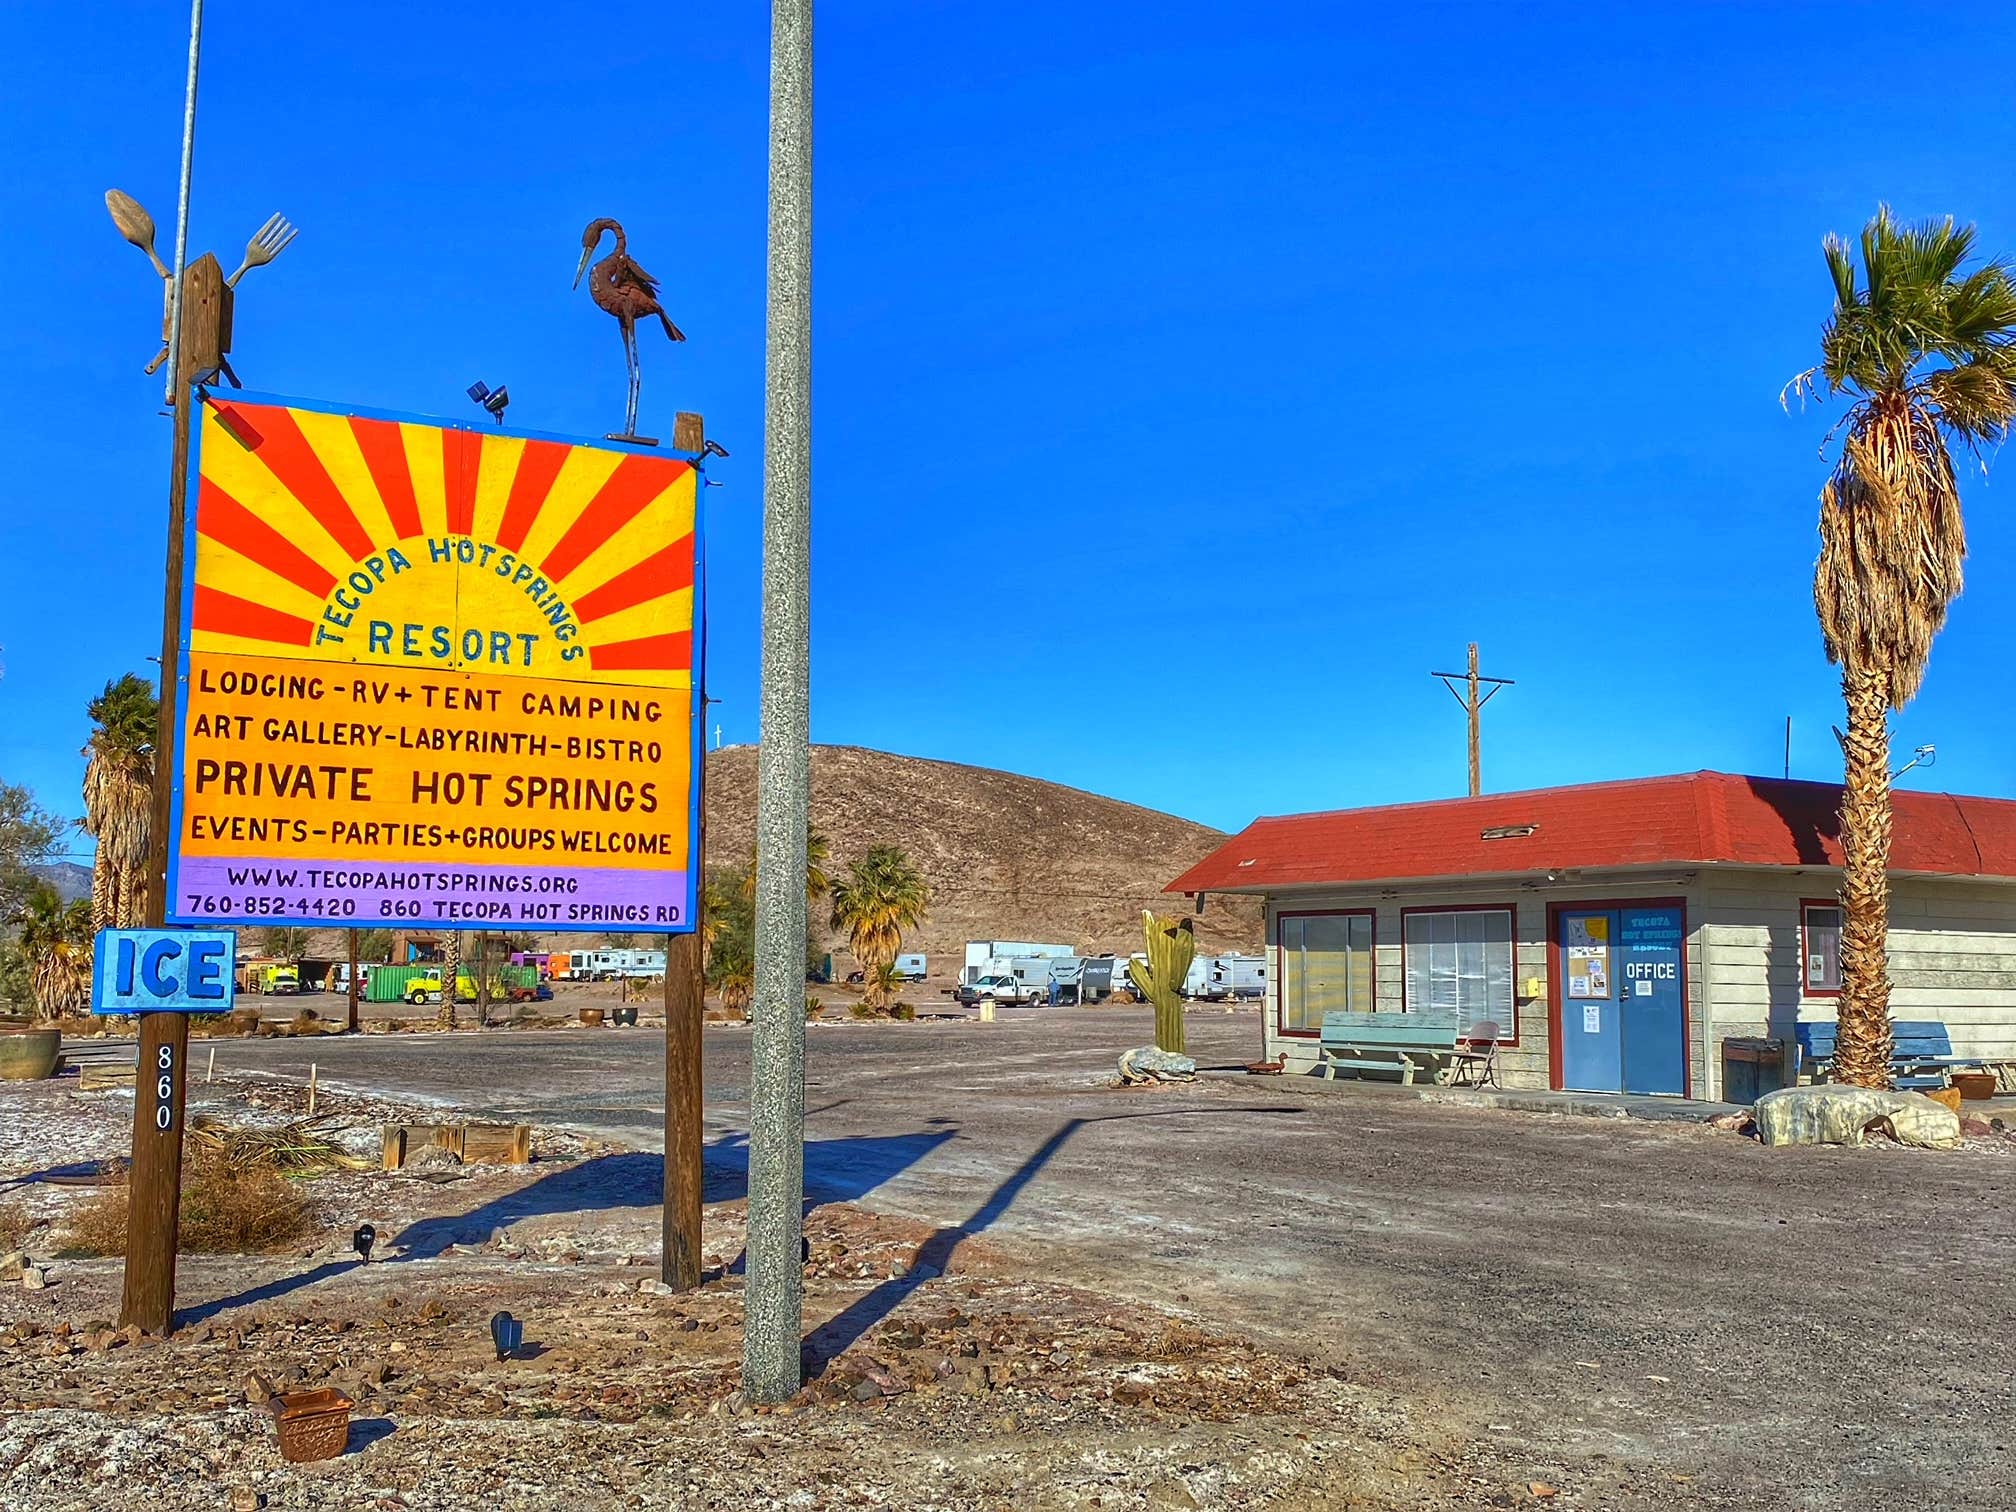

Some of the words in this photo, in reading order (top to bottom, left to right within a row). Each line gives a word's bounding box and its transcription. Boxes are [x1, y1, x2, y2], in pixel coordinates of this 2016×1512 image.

[316, 547, 412, 646] TECOPA
[369, 620, 539, 666] RESORT
[522, 692, 662, 722] CAMPING
[193, 713, 254, 740] ART
[195, 758, 373, 802] PRIVATE
[412, 771, 492, 806] HOT
[504, 775, 658, 813] SPRINGS
[227, 868, 579, 893] WWW.TECOPAHOTSPRINGS.ORG
[187, 894, 356, 916] 760-852-4420
[379, 900, 421, 917] 860
[433, 901, 512, 919] TECOPA
[520, 903, 561, 920] HOT
[568, 904, 649, 922] SPRINGS
[656, 905, 680, 922] RD
[116, 937, 226, 999] ICE
[1626, 963, 1676, 979] OFFICE
